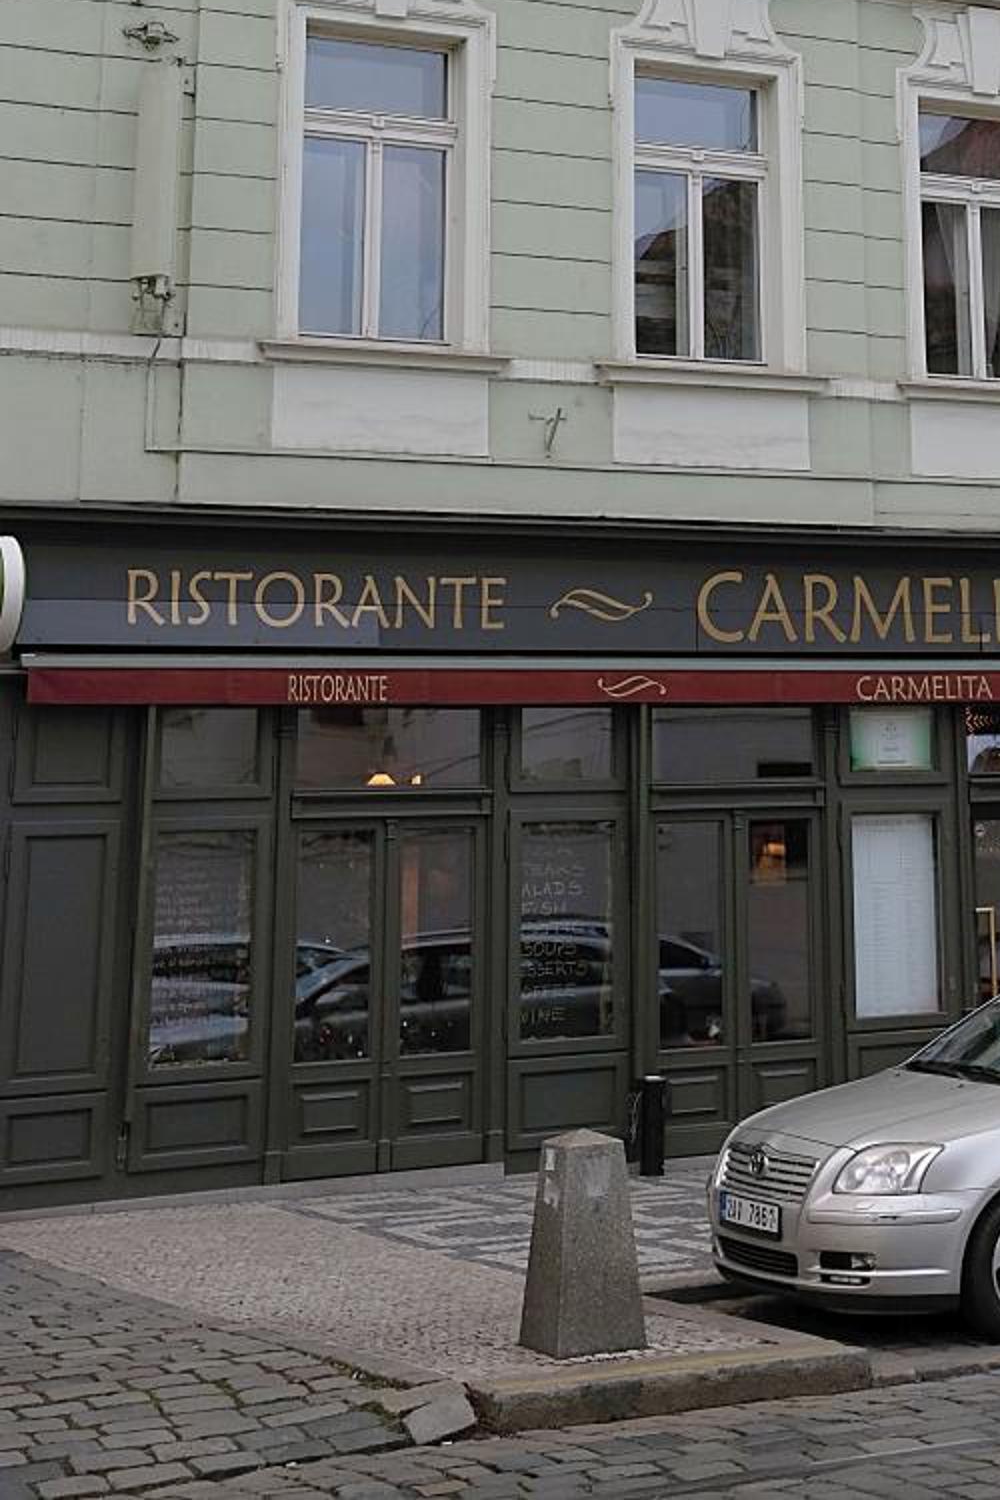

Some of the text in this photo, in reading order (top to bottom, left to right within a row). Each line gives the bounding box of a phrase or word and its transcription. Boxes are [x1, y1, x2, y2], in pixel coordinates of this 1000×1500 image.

[126, 568, 509, 632] RISTORANTE
[287, 675, 389, 702] RISTORANTE
[855, 675, 993, 701] CARMELITA
[520, 881, 584, 898] ALADS
